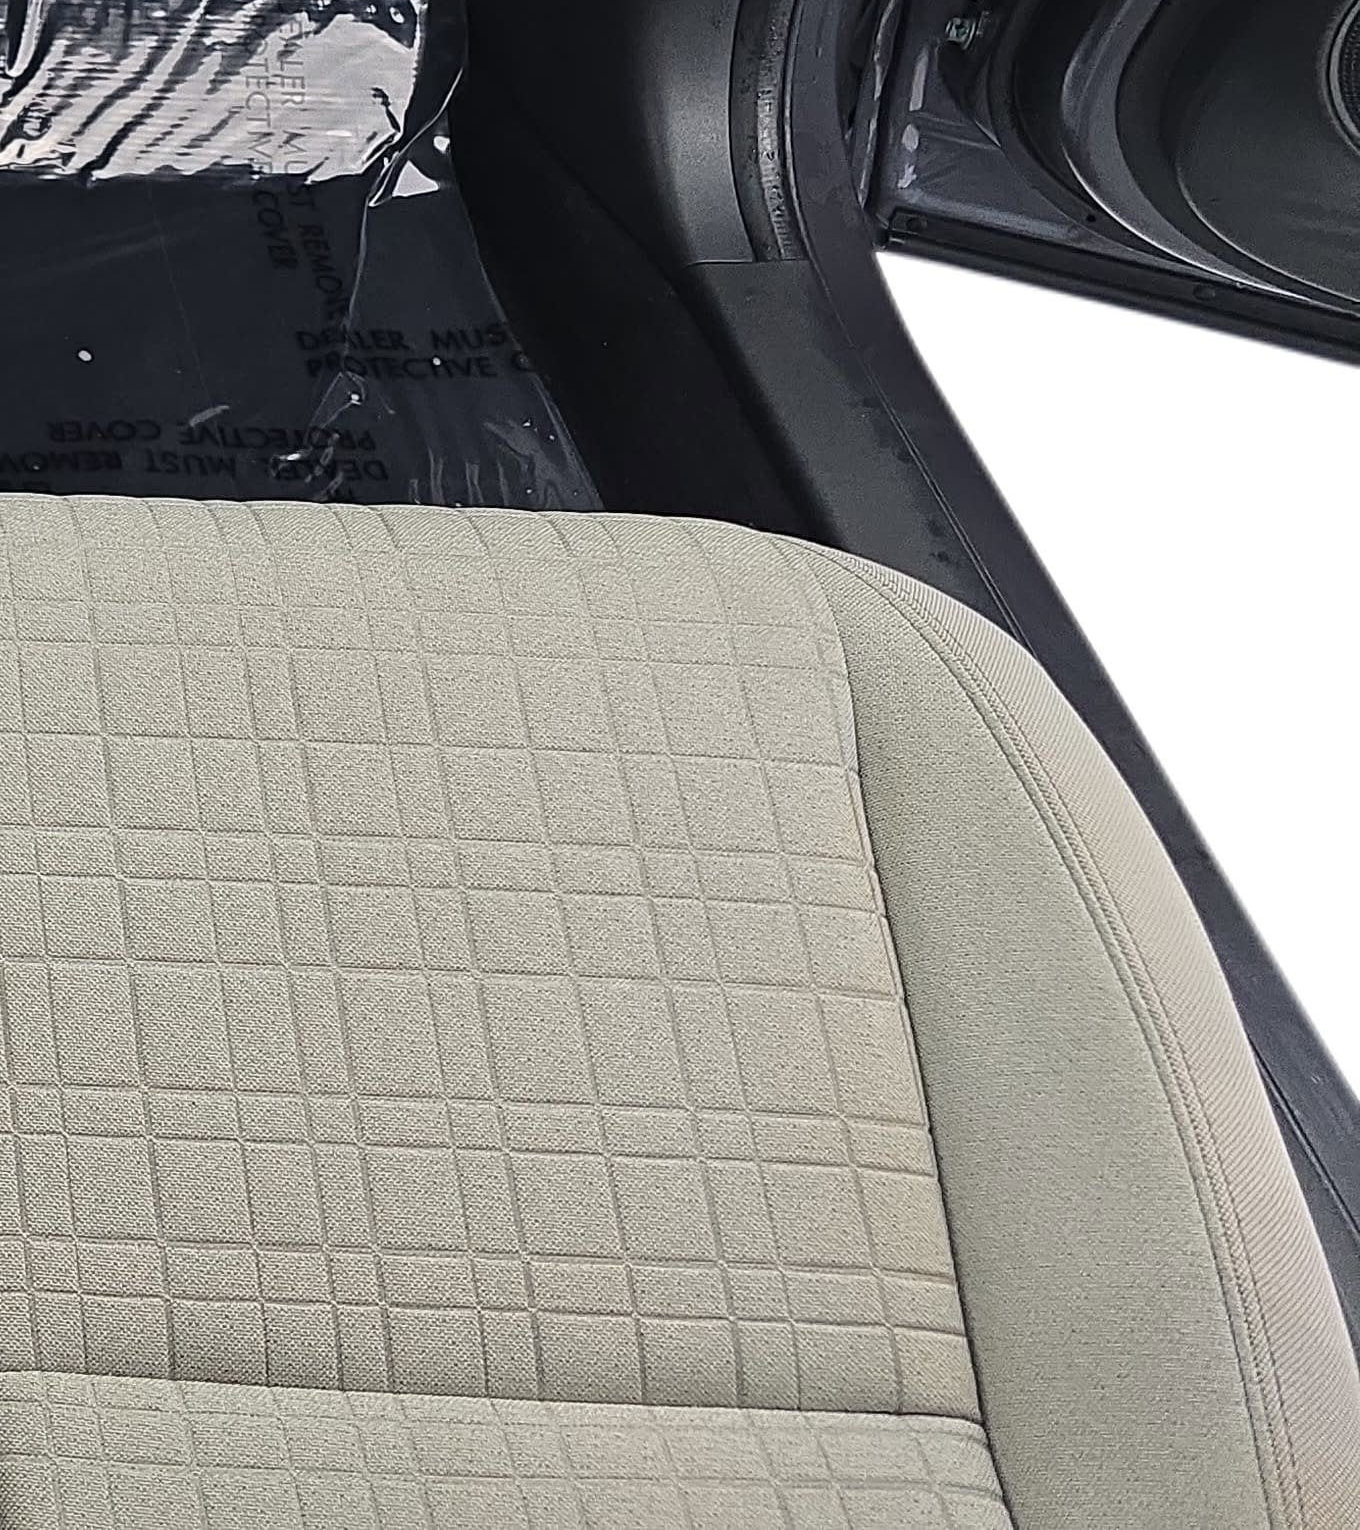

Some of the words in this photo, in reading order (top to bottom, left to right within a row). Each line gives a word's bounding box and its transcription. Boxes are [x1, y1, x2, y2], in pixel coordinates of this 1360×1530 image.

[294, 329, 410, 352] DEALER
[45, 419, 162, 443] COVER
[145, 450, 238, 478] MUST
